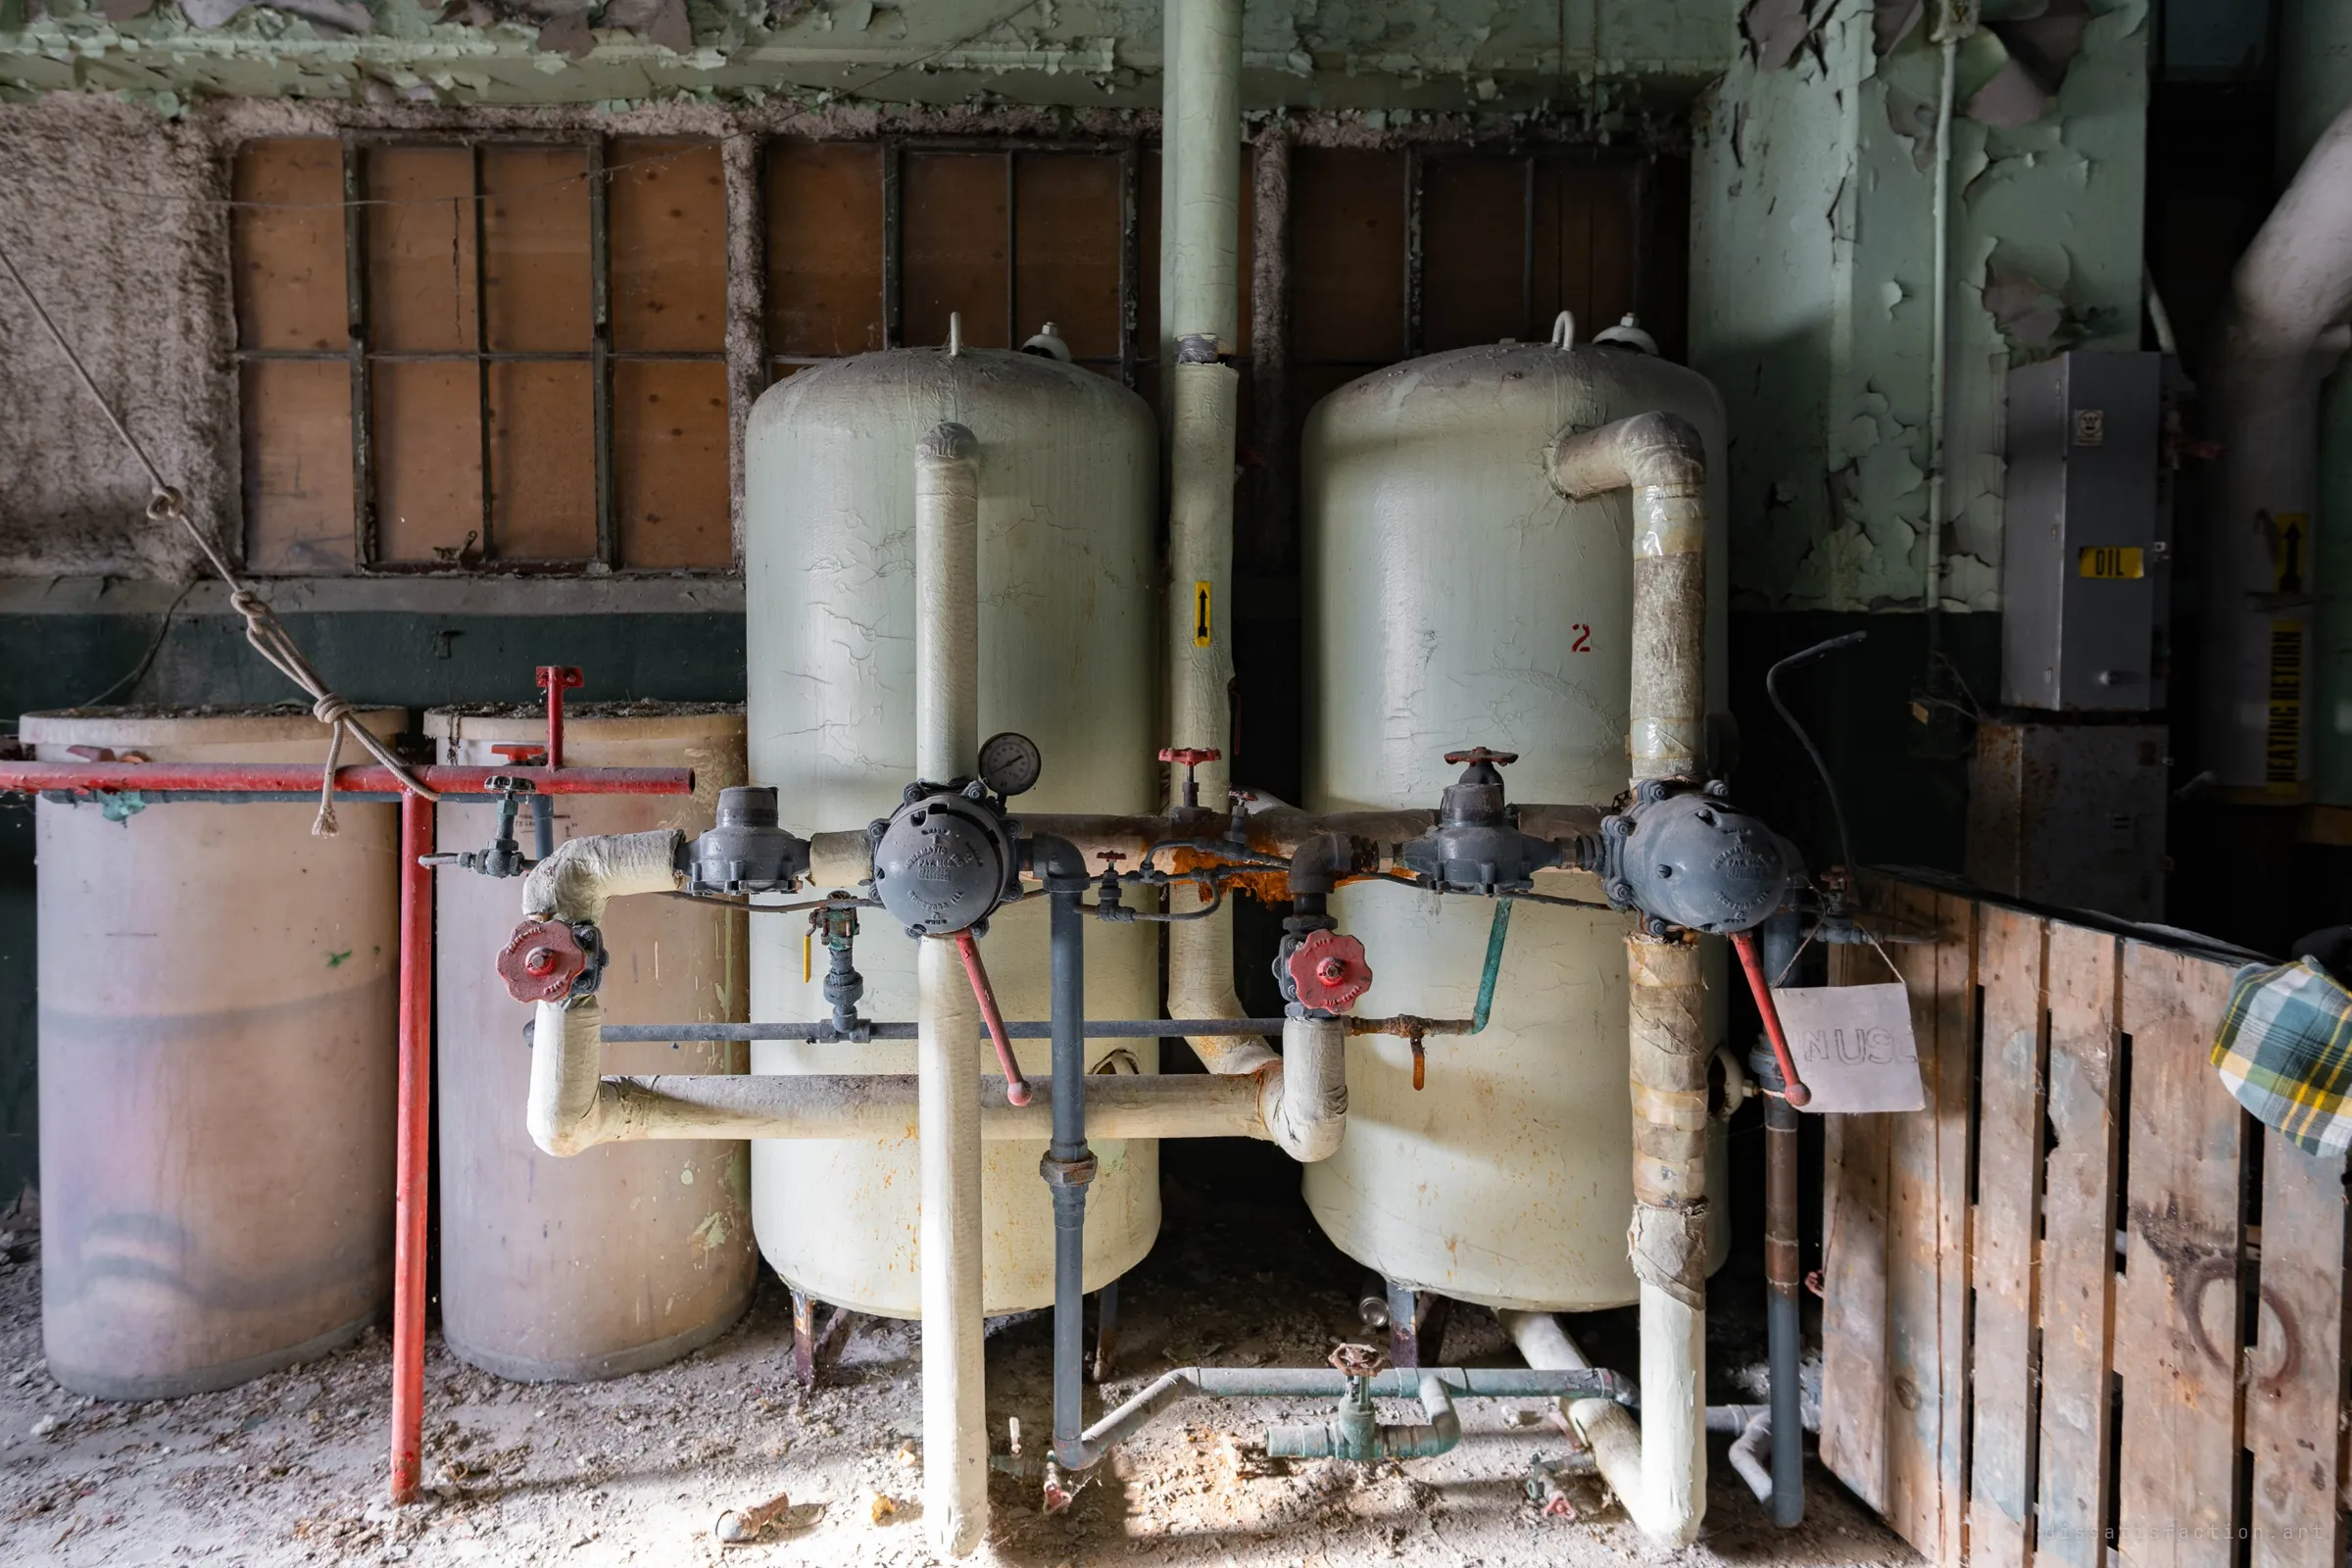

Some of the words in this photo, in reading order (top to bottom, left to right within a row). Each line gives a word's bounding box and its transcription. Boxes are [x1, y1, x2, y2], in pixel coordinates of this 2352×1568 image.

[2095, 549, 2125, 576] OIL
[1571, 623, 1591, 653] 2
[2269, 630, 2303, 701] RETURN
[2266, 706, 2301, 782] HEATING
